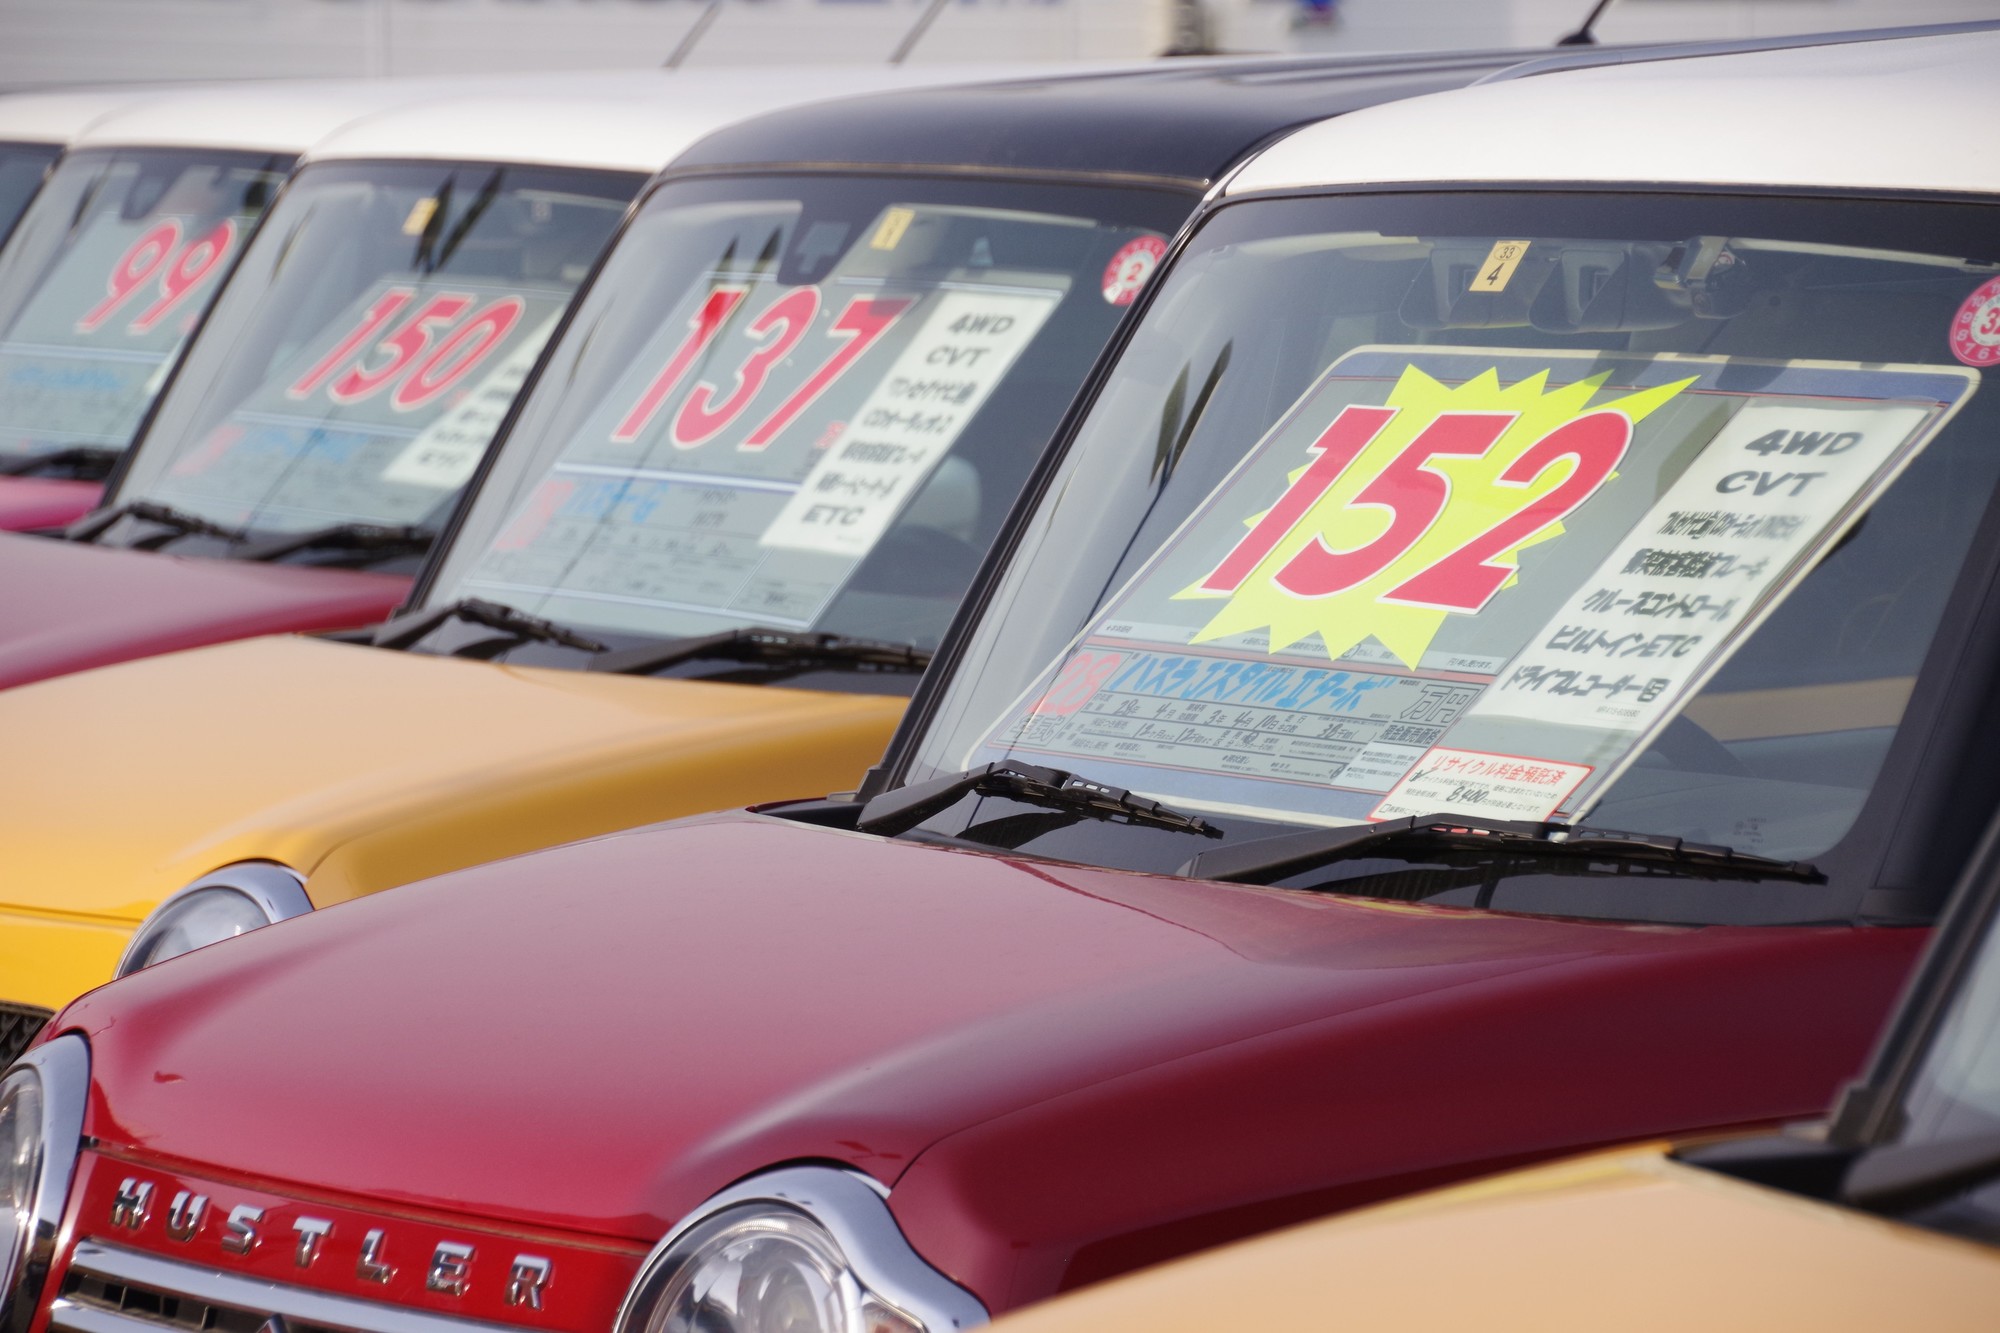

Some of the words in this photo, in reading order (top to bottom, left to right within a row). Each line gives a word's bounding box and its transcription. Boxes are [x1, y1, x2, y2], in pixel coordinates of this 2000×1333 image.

[1500, 246, 1516, 259] 33
[74, 217, 237, 335] 99
[1486, 261, 1505, 286] 4
[946, 311, 1017, 336] 4WD
[287, 287, 526, 412] 150
[925, 345, 992, 367] CVT
[609, 282, 922, 452] 137
[1744, 429, 1864, 457] 4WD
[1715, 470, 1829, 497] CVT
[800, 504, 866, 526] ETC
[1199, 403, 1636, 617] 152
[1400, 683, 1483, 725] 万円
[1431, 755, 1568, 786] リサイクル料金預託済
[109, 1177, 556, 1312] HUSTLER
